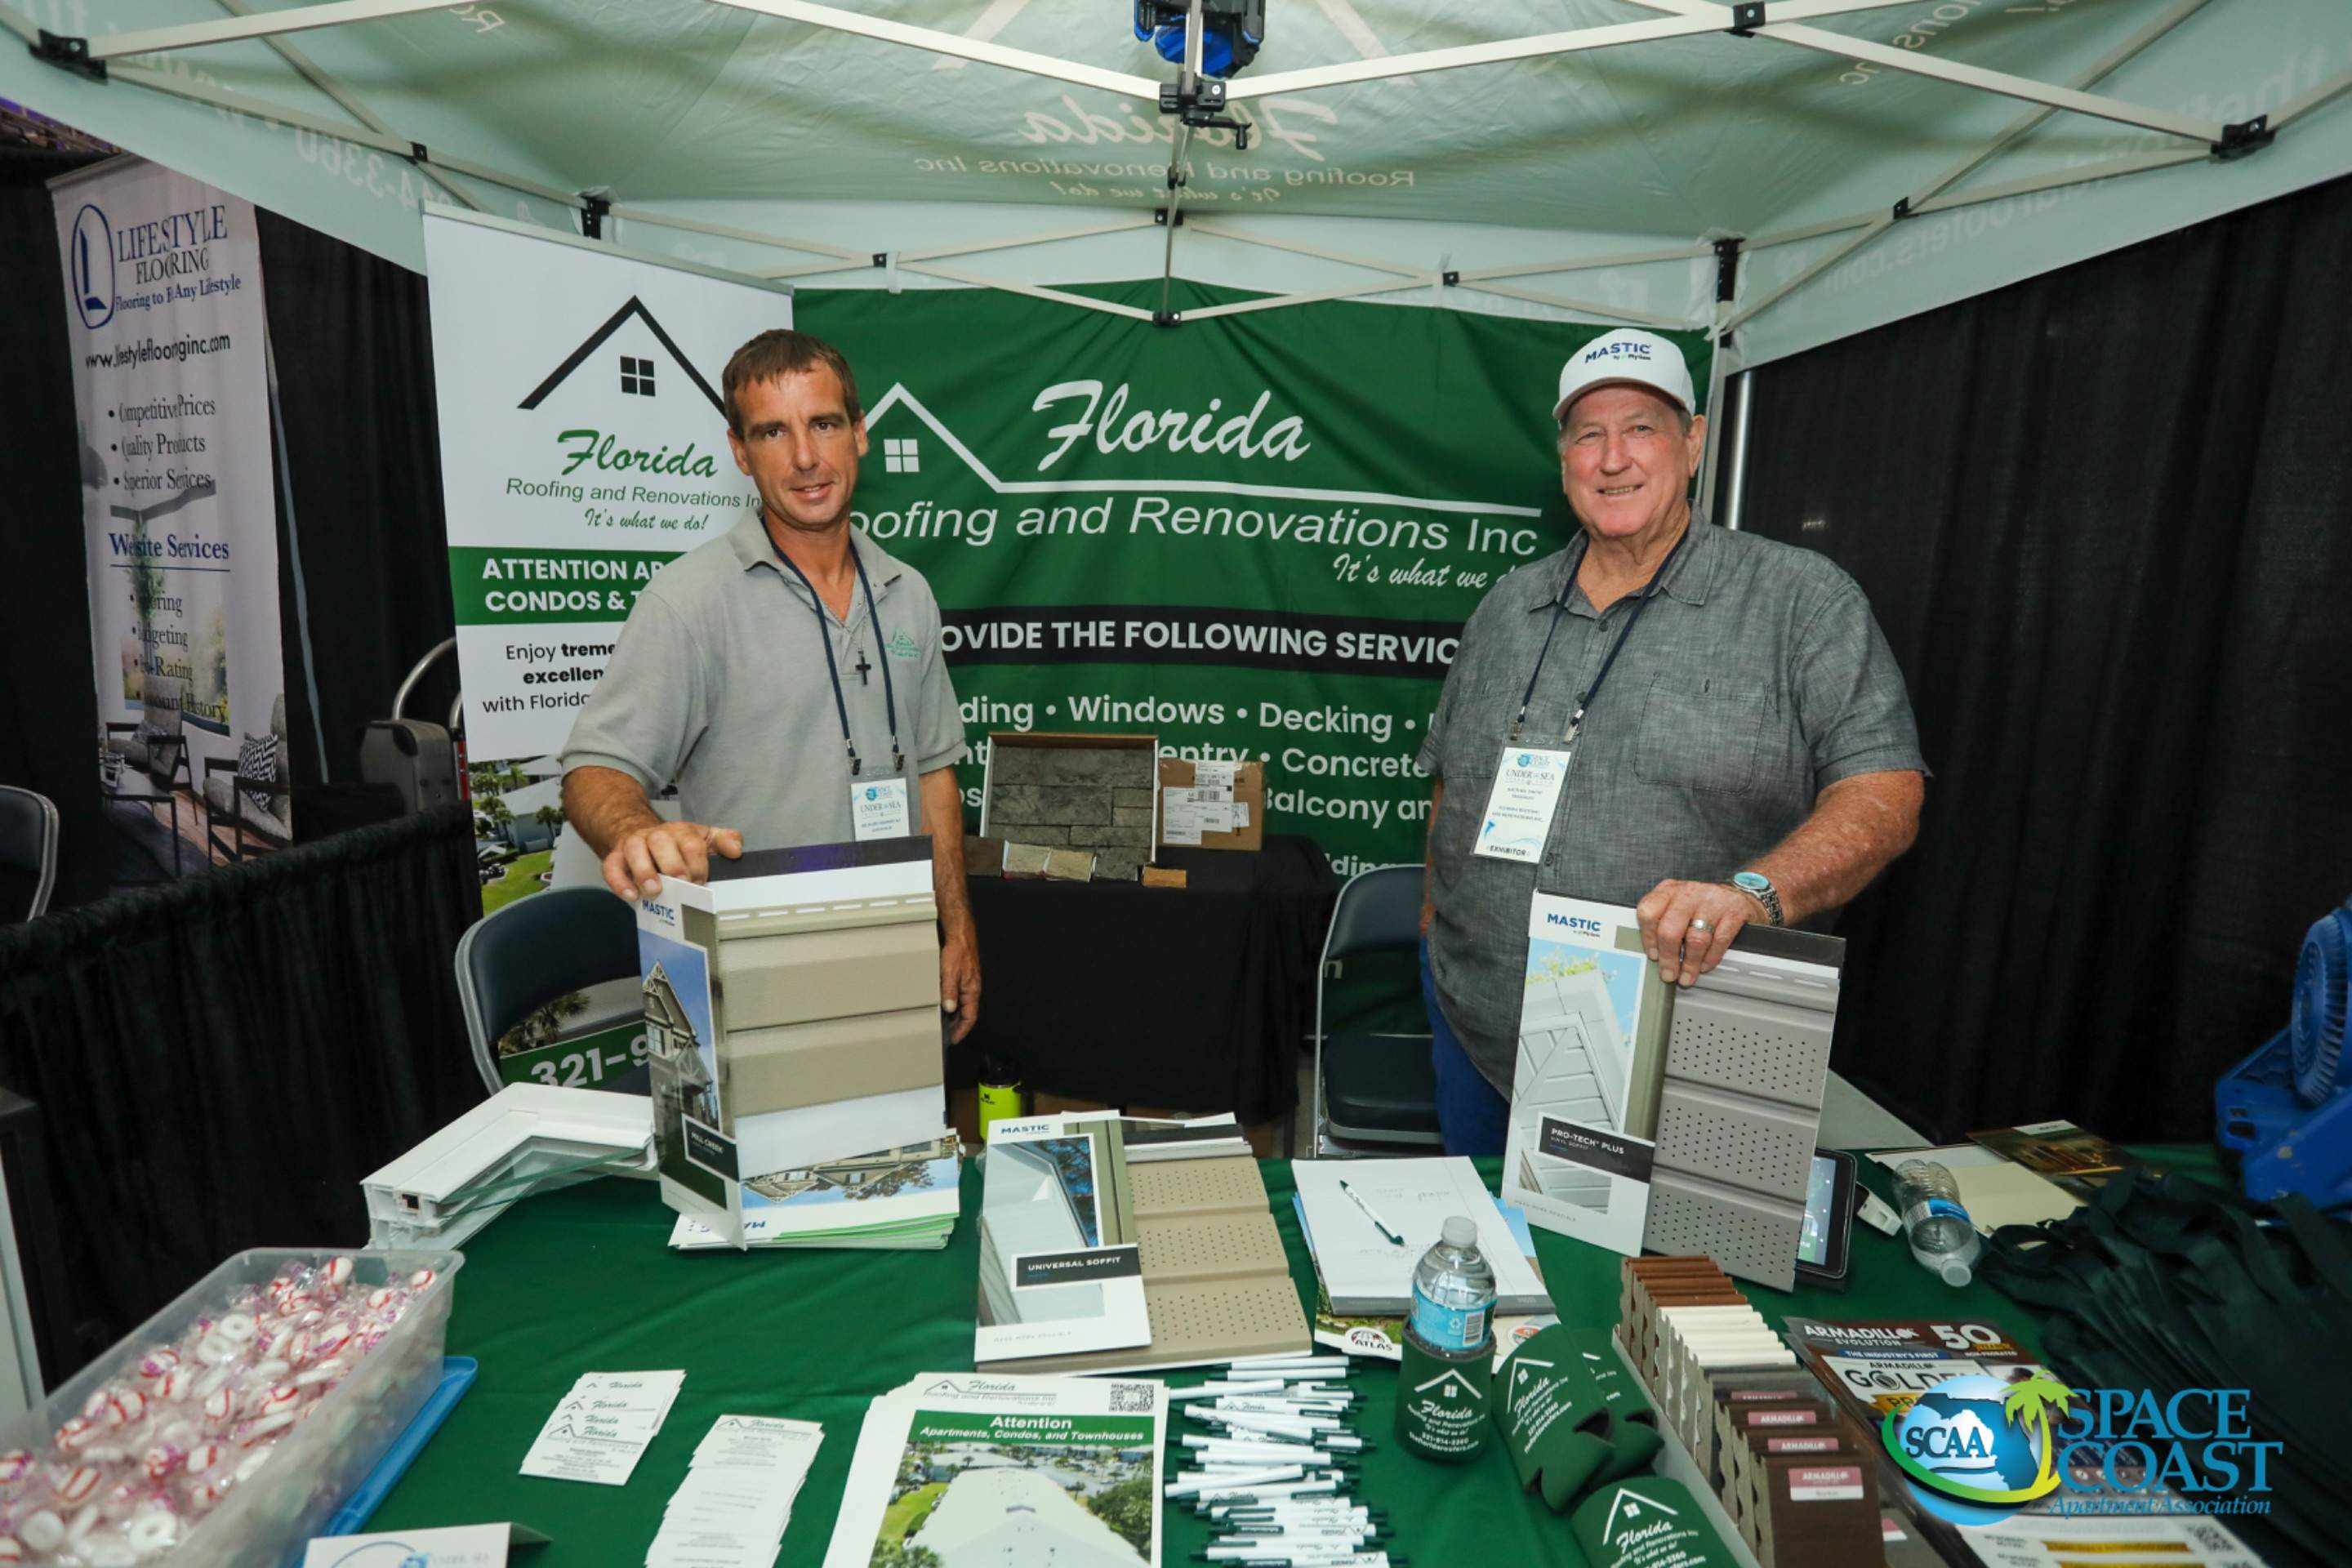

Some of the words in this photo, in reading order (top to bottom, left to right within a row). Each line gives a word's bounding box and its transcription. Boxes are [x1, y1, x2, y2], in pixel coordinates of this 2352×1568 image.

[118, 206, 228, 262] LIFESTYLE
[153, 292, 163, 304] to
[175, 283, 197, 303] Any
[199, 274, 241, 298] Liestyle
[1585, 342, 1651, 363] MASTIC
[1032, 379, 1311, 472] Florida
[156, 433, 205, 455] Proucts
[557, 430, 719, 478] Florida
[506, 478, 584, 502] Roofing
[590, 484, 626, 501] and
[632, 487, 742, 508] Renovations
[746, 494, 761, 508] In
[584, 508, 613, 527] It's
[620, 511, 656, 529] what
[660, 517, 679, 530] we
[684, 514, 710, 531] do!
[849, 501, 998, 546] oofing
[1017, 497, 1113, 536] and
[1129, 496, 1450, 550] Renovations
[1468, 518, 1539, 555] Inc
[482, 558, 627, 581] ATTENTION
[1334, 553, 1380, 583] It's
[1389, 559, 1450, 588] what
[1457, 572, 1487, 589] we
[485, 590, 601, 612] CONDOS
[607, 590, 626, 611] &
[506, 644, 556, 663] Enjoy
[942, 622, 1042, 652] OVIDE
[1052, 621, 1116, 648] THE
[1125, 621, 1326, 655] FOLLOWING
[1335, 631, 1459, 665] SERVIC
[483, 696, 524, 713] with
[959, 695, 1034, 733] ding
[1067, 694, 1225, 724] Windows
[1260, 702, 1392, 742] Decking
[1282, 747, 1429, 778] Concrete
[1398, 799, 1432, 820] an
[1548, 913, 1601, 932] MASTIC
[1001, 1124, 1050, 1134] MASTIC
[1601, 1142, 1625, 1154] PLUS
[1028, 1260, 1084, 1271] UNIVERSAL
[1086, 1256, 1121, 1266] SOFFIT
[1354, 1339, 1392, 1352] ATLAS
[1834, 1338, 1902, 1347] EVOLUTION
[1931, 1324, 2002, 1350] 50
[1864, 1351, 1913, 1359] INDUSTRY'S
[1420, 1399, 1473, 1419] Florida
[990, 1415, 1071, 1429] Attention
[920, 1427, 991, 1439] Apartments,
[994, 1430, 1041, 1441] Condos,
[1045, 1432, 1068, 1441] and
[1071, 1431, 1143, 1441] Townhouses
[1615, 1519, 1673, 1555] Florida
